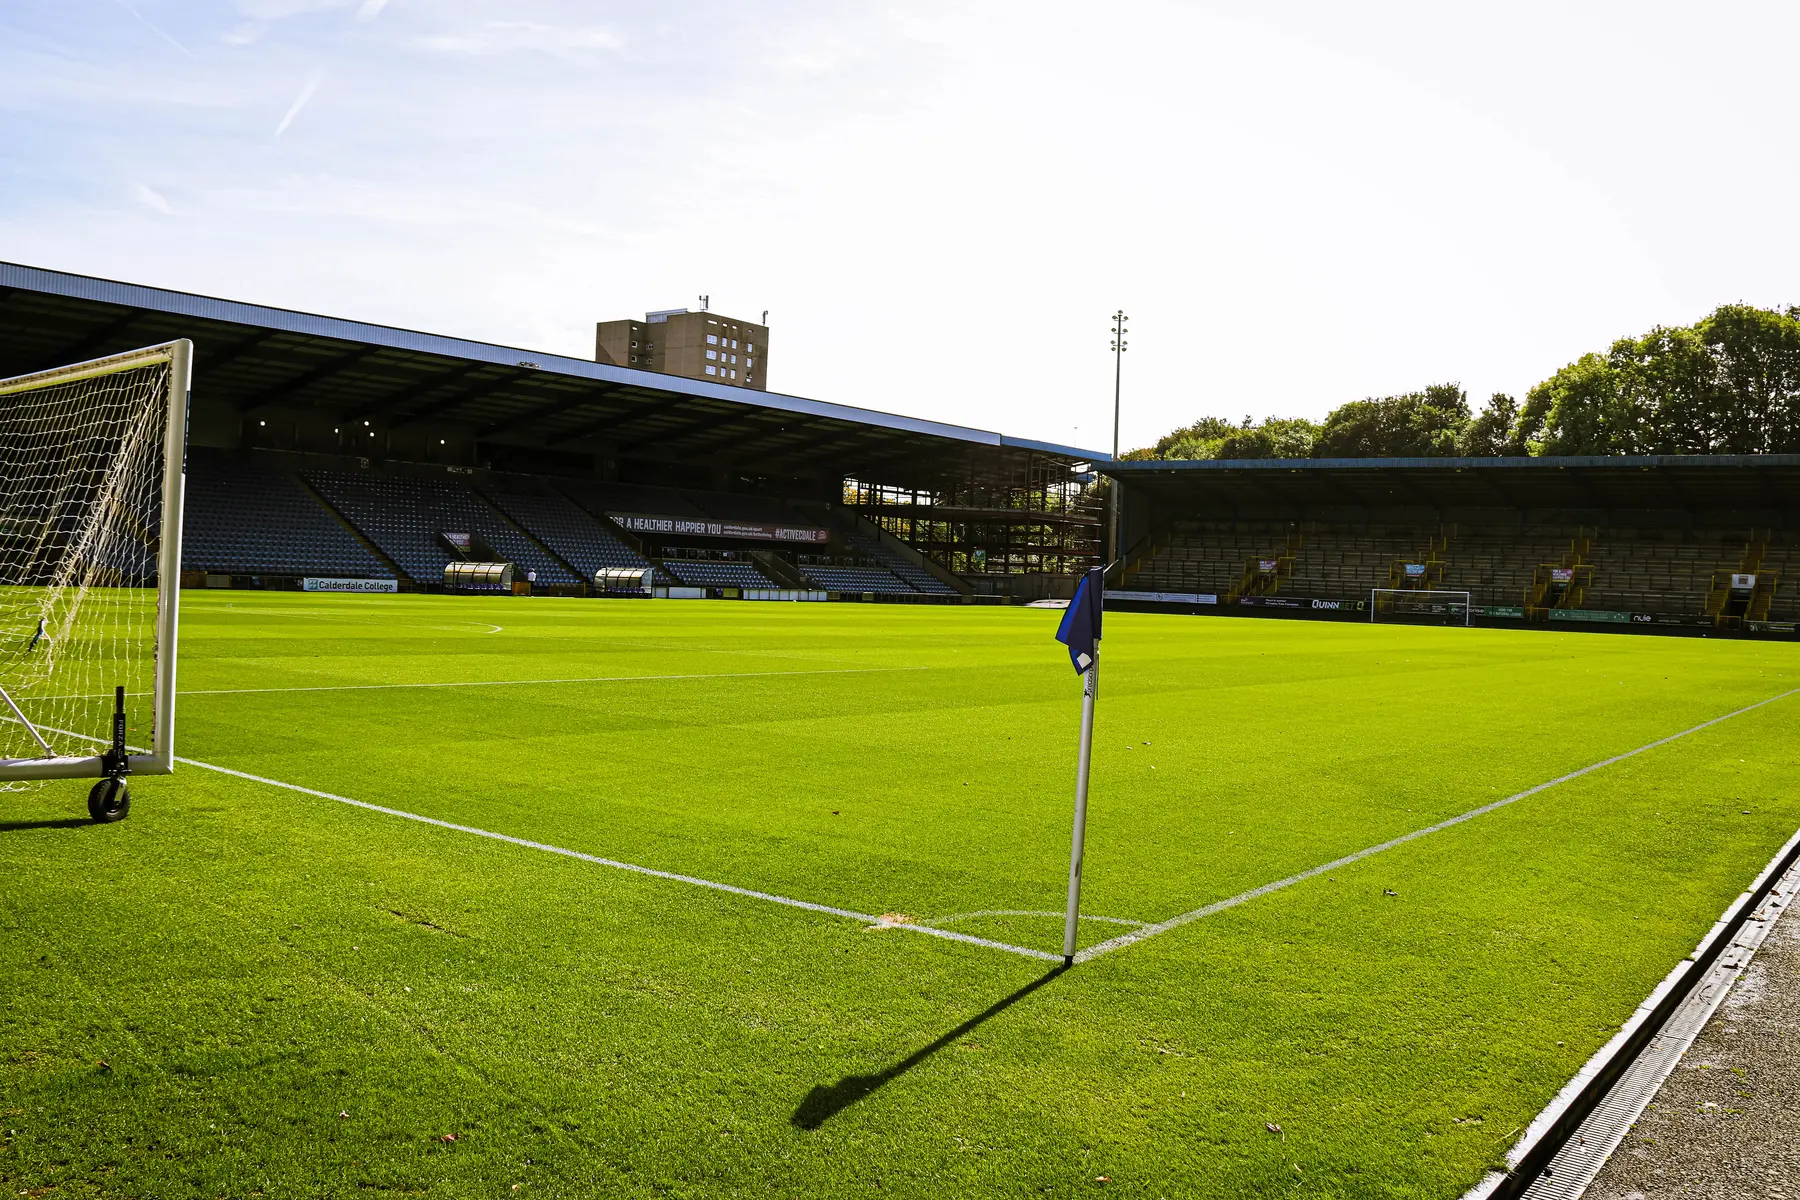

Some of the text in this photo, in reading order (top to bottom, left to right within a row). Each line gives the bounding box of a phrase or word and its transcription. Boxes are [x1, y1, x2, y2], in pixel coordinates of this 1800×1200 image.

[626, 518, 632, 529] A
[634, 518, 673, 532] HEALTHIER
[675, 521, 705, 534] HAPPIER
[707, 523, 721, 535] YOU
[319, 580, 393, 592] Calderdale College
